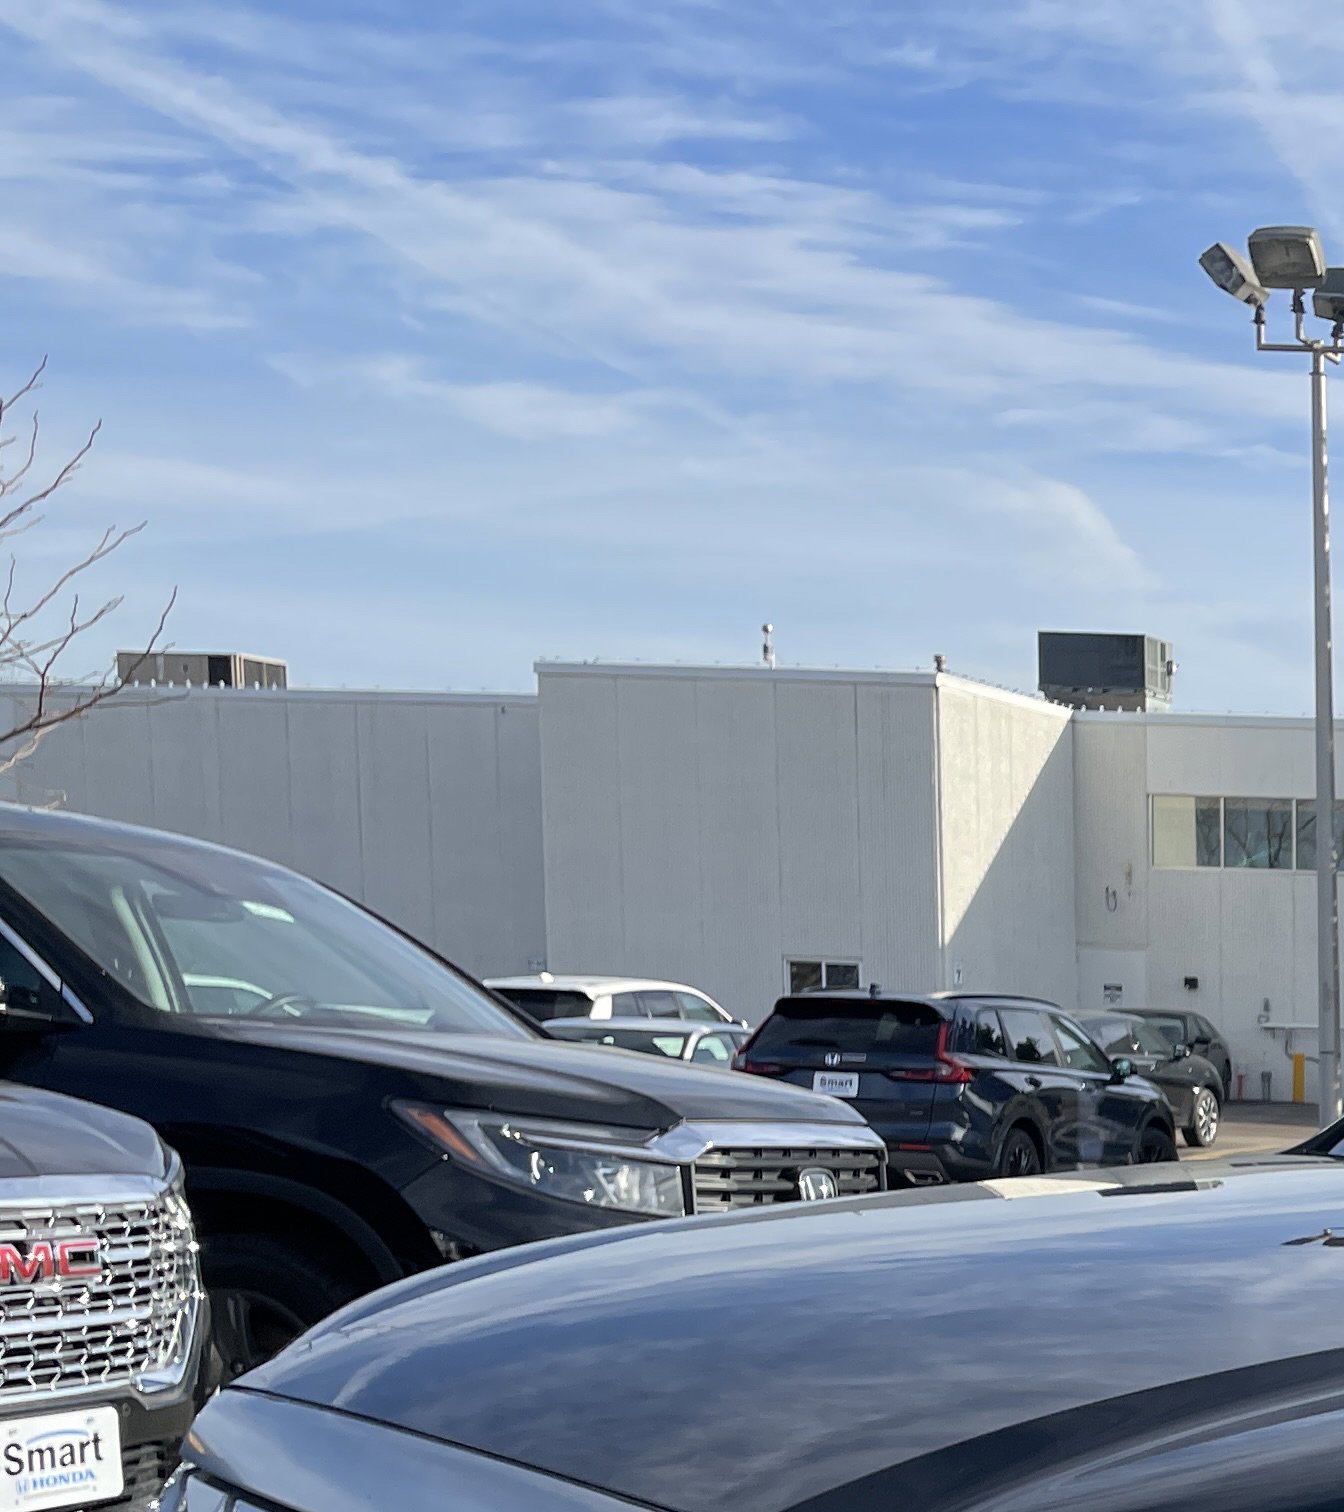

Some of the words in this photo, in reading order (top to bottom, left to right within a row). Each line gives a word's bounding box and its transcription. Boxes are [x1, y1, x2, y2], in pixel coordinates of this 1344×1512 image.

[0, 1239, 103, 1285] MC
[3, 1432, 103, 1476] Smart
[32, 1470, 95, 1491] HONDA
